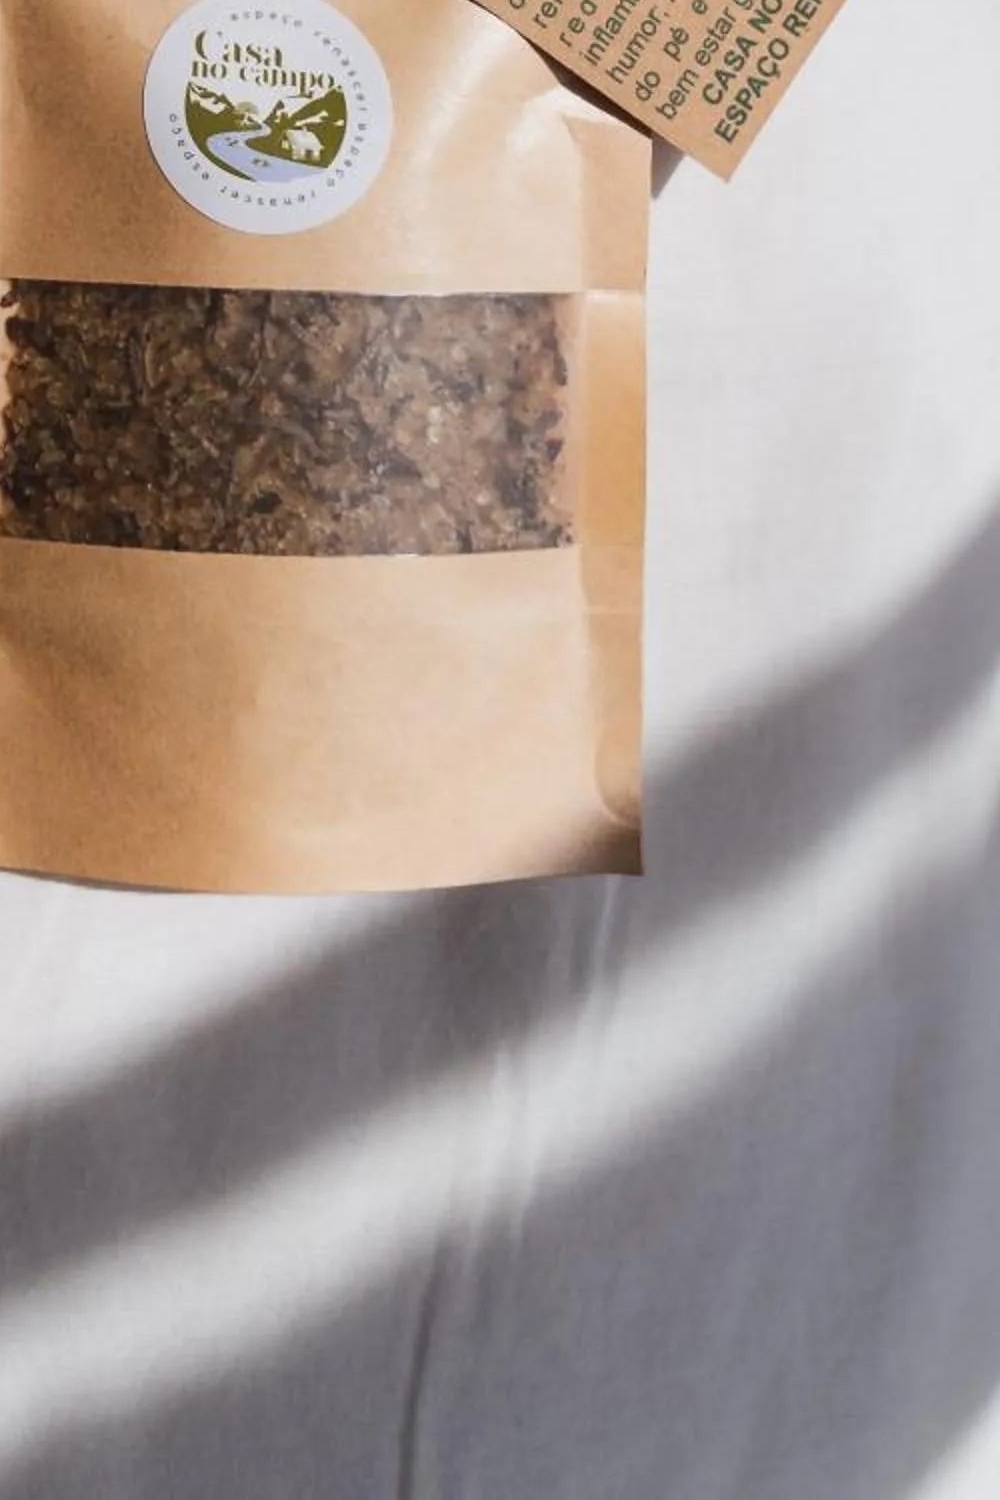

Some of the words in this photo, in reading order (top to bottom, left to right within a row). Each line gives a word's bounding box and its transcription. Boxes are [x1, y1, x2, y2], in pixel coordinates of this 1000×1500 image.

[190, 59, 227, 79] no
[240, 64, 343, 98] campo.
[192, 28, 284, 68] Casa
[635, 71, 660, 102] do
[663, 28, 689, 62] pé
[655, 69, 699, 120] bem
[695, 6, 736, 66] estar
[702, 36, 758, 105] CASA
[714, 38, 789, 143] ESPAÇO
